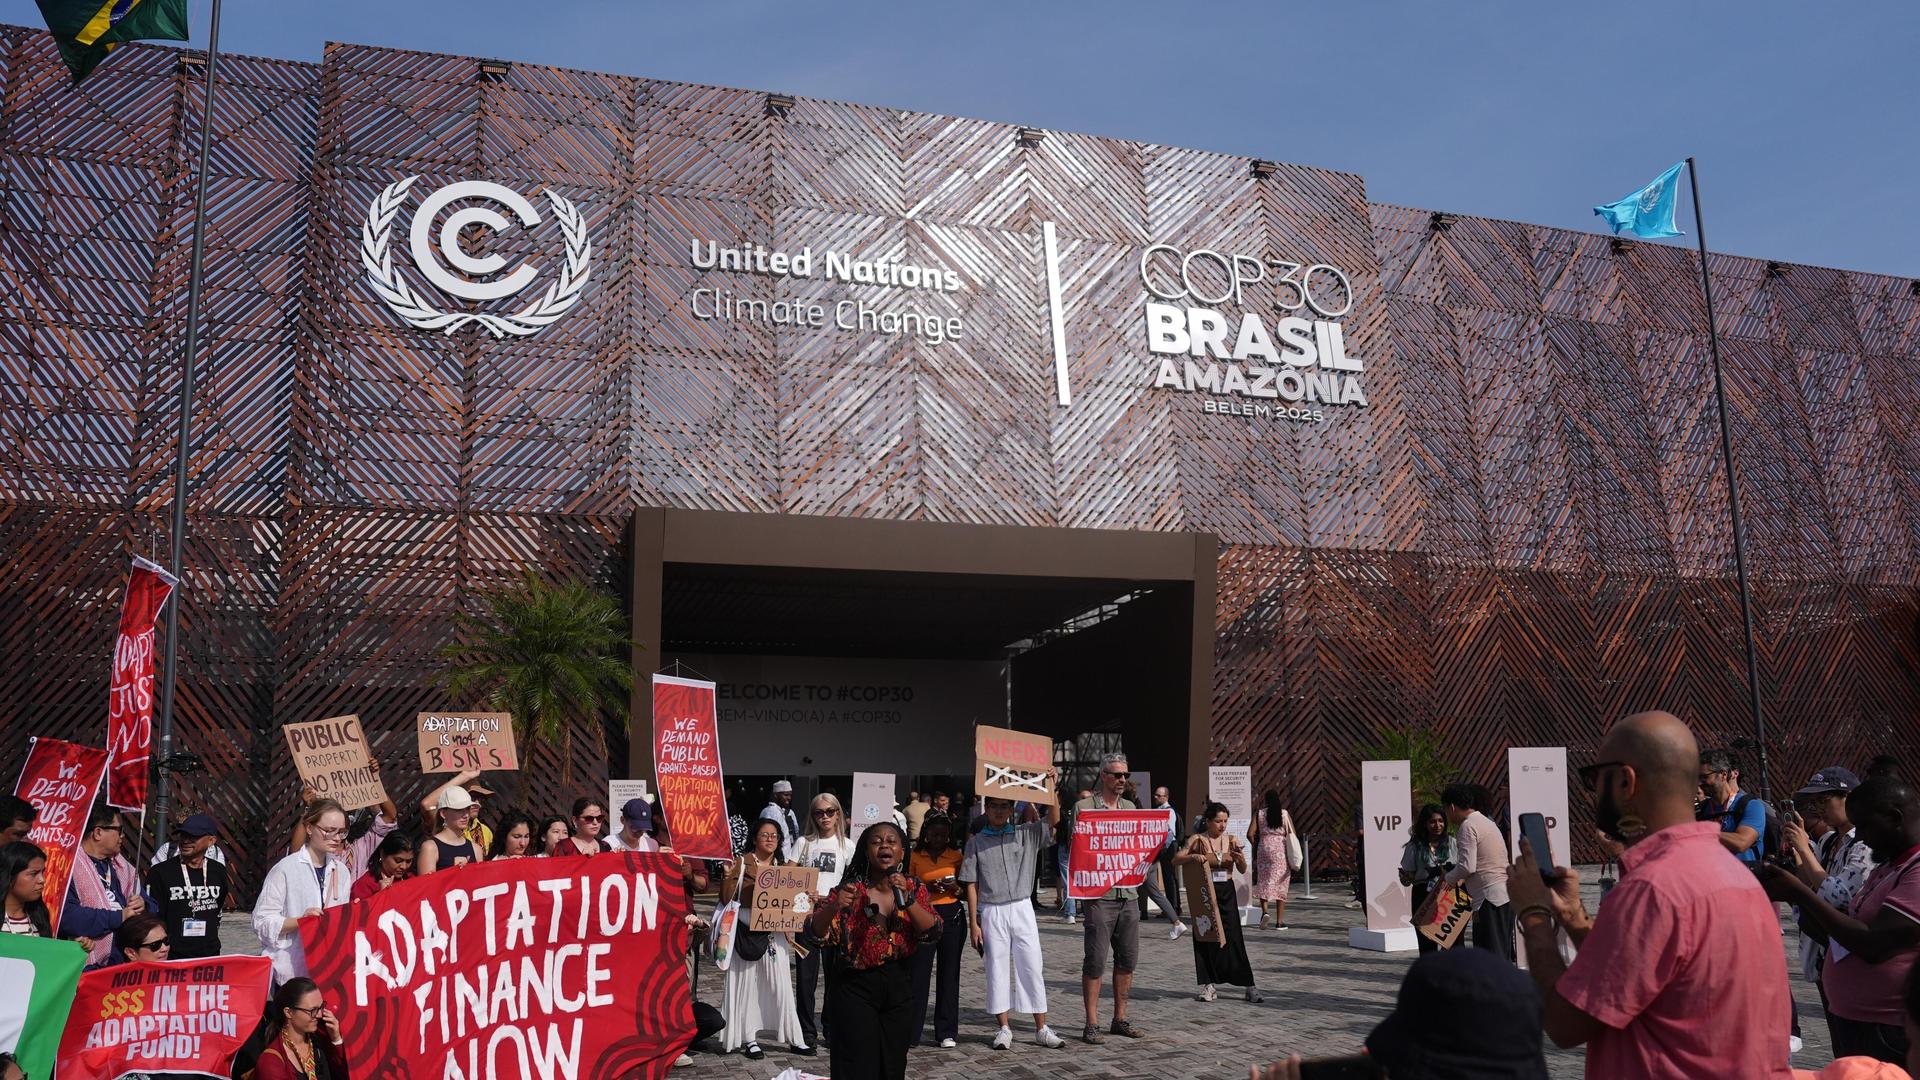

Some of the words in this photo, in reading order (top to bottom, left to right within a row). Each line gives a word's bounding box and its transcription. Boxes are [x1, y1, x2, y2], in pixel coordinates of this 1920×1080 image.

[691, 238, 811, 278] United
[825, 250, 961, 292] Nations
[1140, 243, 1265, 305] COP
[1270, 259, 1352, 318] 30
[691, 288, 825, 330] Climate
[836, 299, 964, 345] Change
[1144, 302, 1363, 373] BRASIL
[1154, 359, 1368, 408] AMAZÔNIA
[1204, 399, 1271, 418] BELÉM
[1275, 405, 1324, 423] 2025
[111, 674, 155, 718] JUS
[718, 683, 801, 701] ELCOME
[804, 684, 832, 700] TO
[837, 685, 914, 703] #COP30
[422, 716, 500, 732] ADAPTATION
[674, 717, 698, 731] WE
[828, 710, 838, 721] A
[842, 710, 902, 724] #COP30
[289, 720, 360, 753] PUBLIC
[439, 733, 450, 746] IS
[478, 732, 488, 745] A
[661, 729, 710, 745] DEMAND
[304, 748, 359, 769] PROPERTY
[661, 744, 708, 762] PUBLIC
[983, 737, 1049, 766] NEEDS
[304, 774, 329, 793] NO
[331, 765, 379, 788] PRIVATE
[658, 761, 717, 776] GRANTS-BASED
[660, 774, 721, 796] ADAPTATION
[665, 792, 718, 811] FINANCE
[1095, 820, 1138, 834] WITHOUT
[1374, 815, 1402, 831] VIP
[1090, 835, 1099, 850] IS
[1102, 835, 1135, 850] EMPTY
[758, 868, 811, 889] Global
[169, 885, 221, 901] RTBU
[754, 912, 804, 931] Adaptatio
[353, 872, 660, 1007] ADAPTATION
[112, 967, 144, 988] MOI
[147, 970, 160, 984] IN
[164, 968, 187, 983] THE
[192, 965, 224, 983] GGA
[100, 988, 145, 1020] $$$
[152, 985, 178, 1013] IN
[186, 984, 230, 1012] THE
[413, 943, 614, 1055] FINANCE
[85, 1010, 238, 1050] ADAPTATION
[125, 1033, 201, 1061] FUND!
[442, 1018, 584, 1080] NOW
